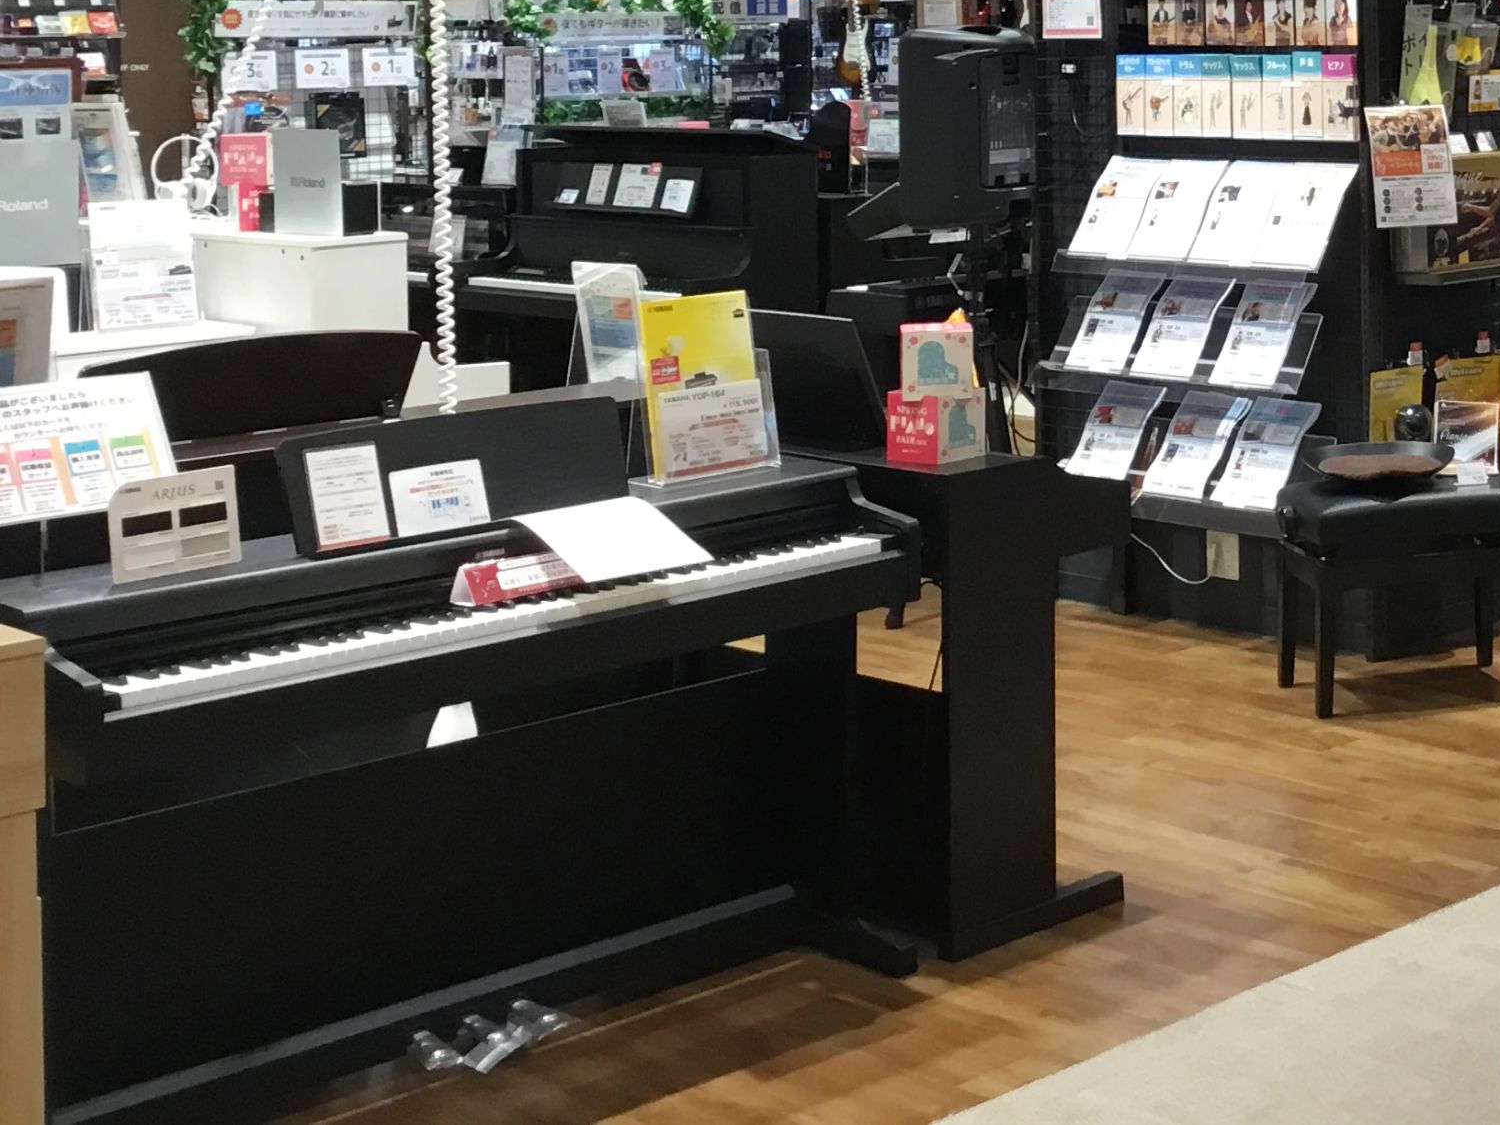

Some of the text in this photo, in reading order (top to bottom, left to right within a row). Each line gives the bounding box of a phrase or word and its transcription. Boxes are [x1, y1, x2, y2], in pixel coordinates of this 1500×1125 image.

[712, 2, 742, 15] 配信
[1265, 60, 1287, 71] フルート
[1326, 61, 1345, 71] ピアノ
[0, 197, 48, 212] Roland
[889, 414, 935, 436] PIANO
[152, 483, 197, 501] ARIUS
